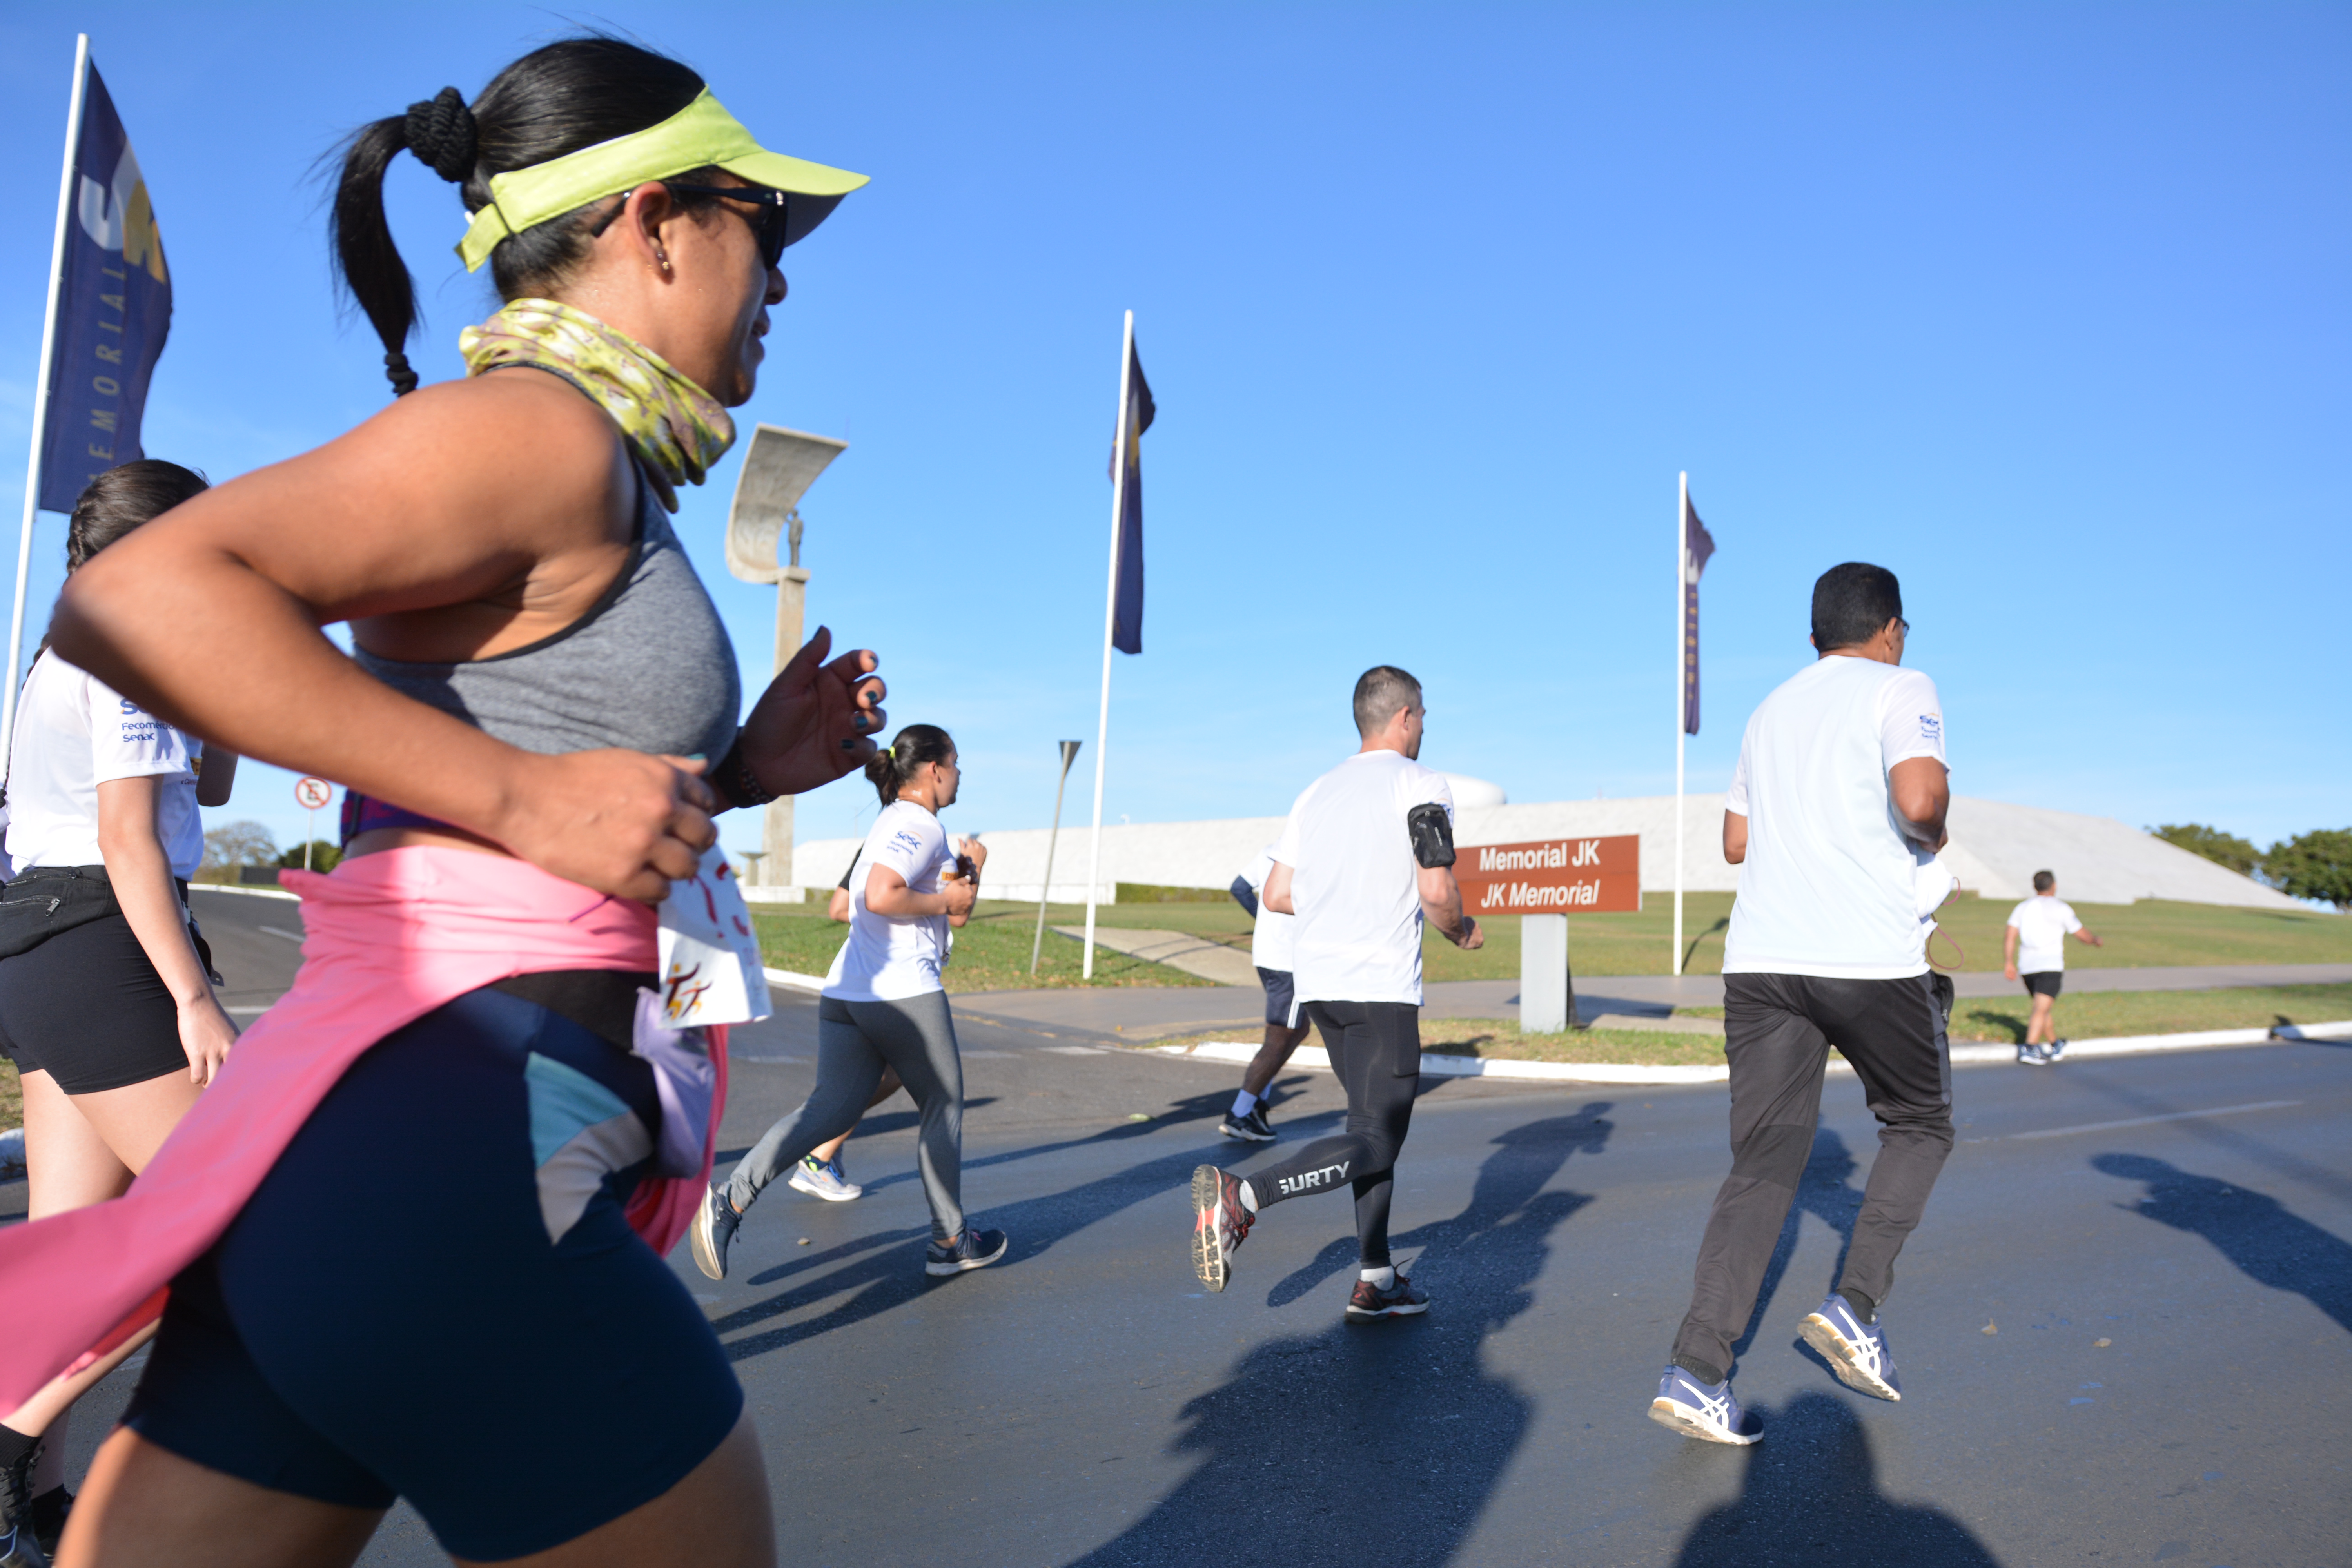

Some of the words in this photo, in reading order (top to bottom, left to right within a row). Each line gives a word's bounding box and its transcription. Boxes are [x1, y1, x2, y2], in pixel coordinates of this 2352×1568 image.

[87, 267, 127, 481] EMORIAL
[1479, 842, 1567, 871] Memorial
[1572, 839, 1601, 867] JK
[1481, 882, 1507, 908] JK
[1508, 878, 1601, 907] Memorial
[1278, 1160, 1350, 1195] SURTY
